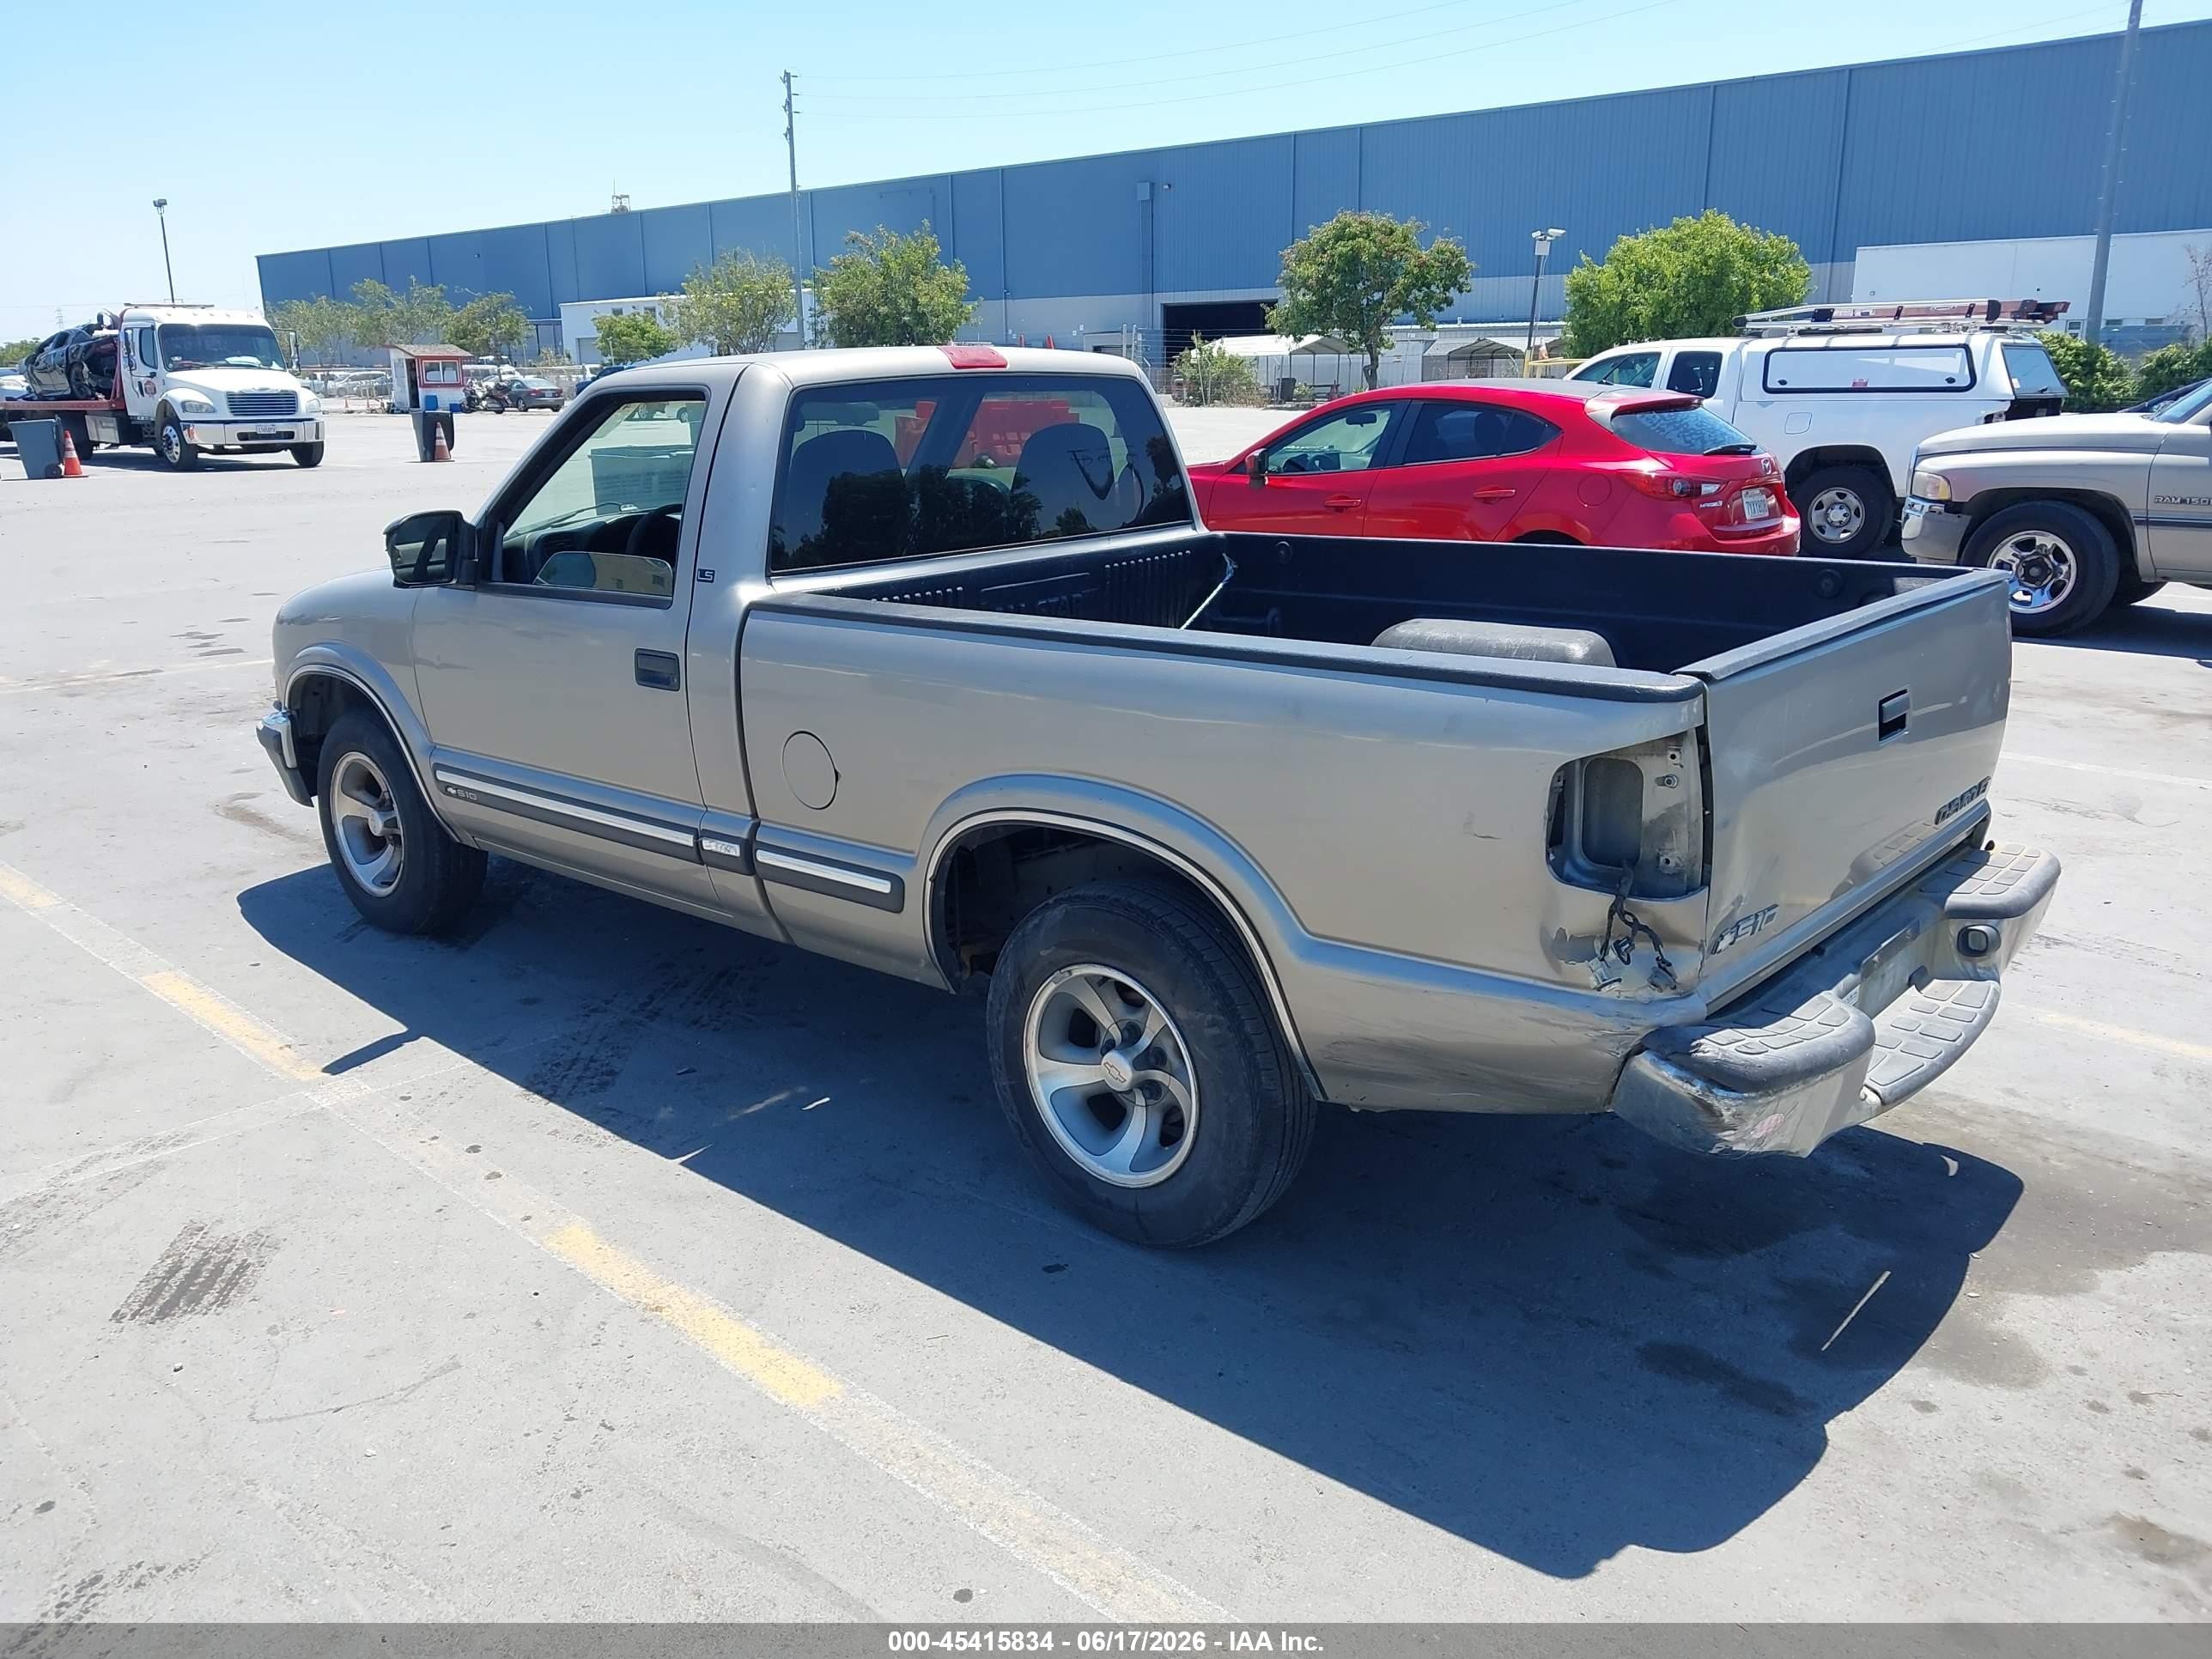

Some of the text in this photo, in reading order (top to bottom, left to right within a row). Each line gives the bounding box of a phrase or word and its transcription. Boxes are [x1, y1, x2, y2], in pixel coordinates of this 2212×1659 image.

[2154, 495, 2212, 506] RAM 150
[697, 569, 714, 582] LS
